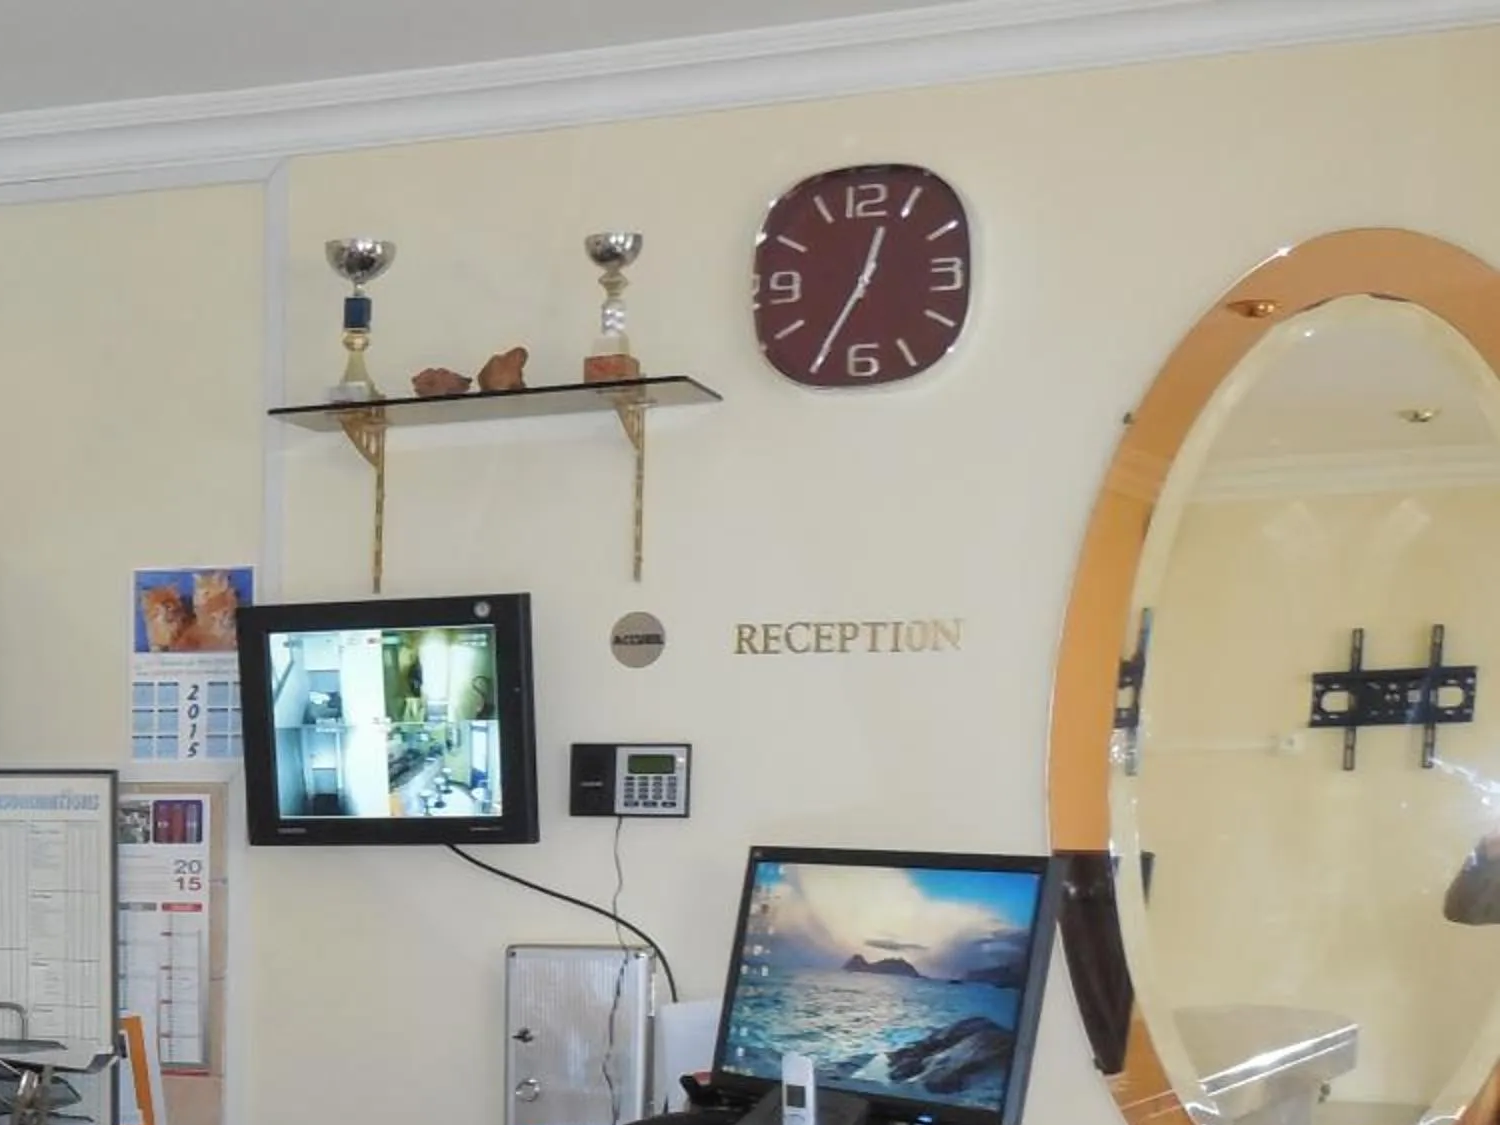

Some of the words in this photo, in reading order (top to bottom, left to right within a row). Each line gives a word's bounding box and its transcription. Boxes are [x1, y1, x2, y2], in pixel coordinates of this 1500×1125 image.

[845, 183, 888, 218] 12
[769, 270, 801, 304] 9
[929, 256, 964, 291] 3
[846, 343, 880, 377] 6
[733, 618, 966, 655] RECEPTION
[174, 859, 203, 876] 20
[174, 876, 203, 892] 15
